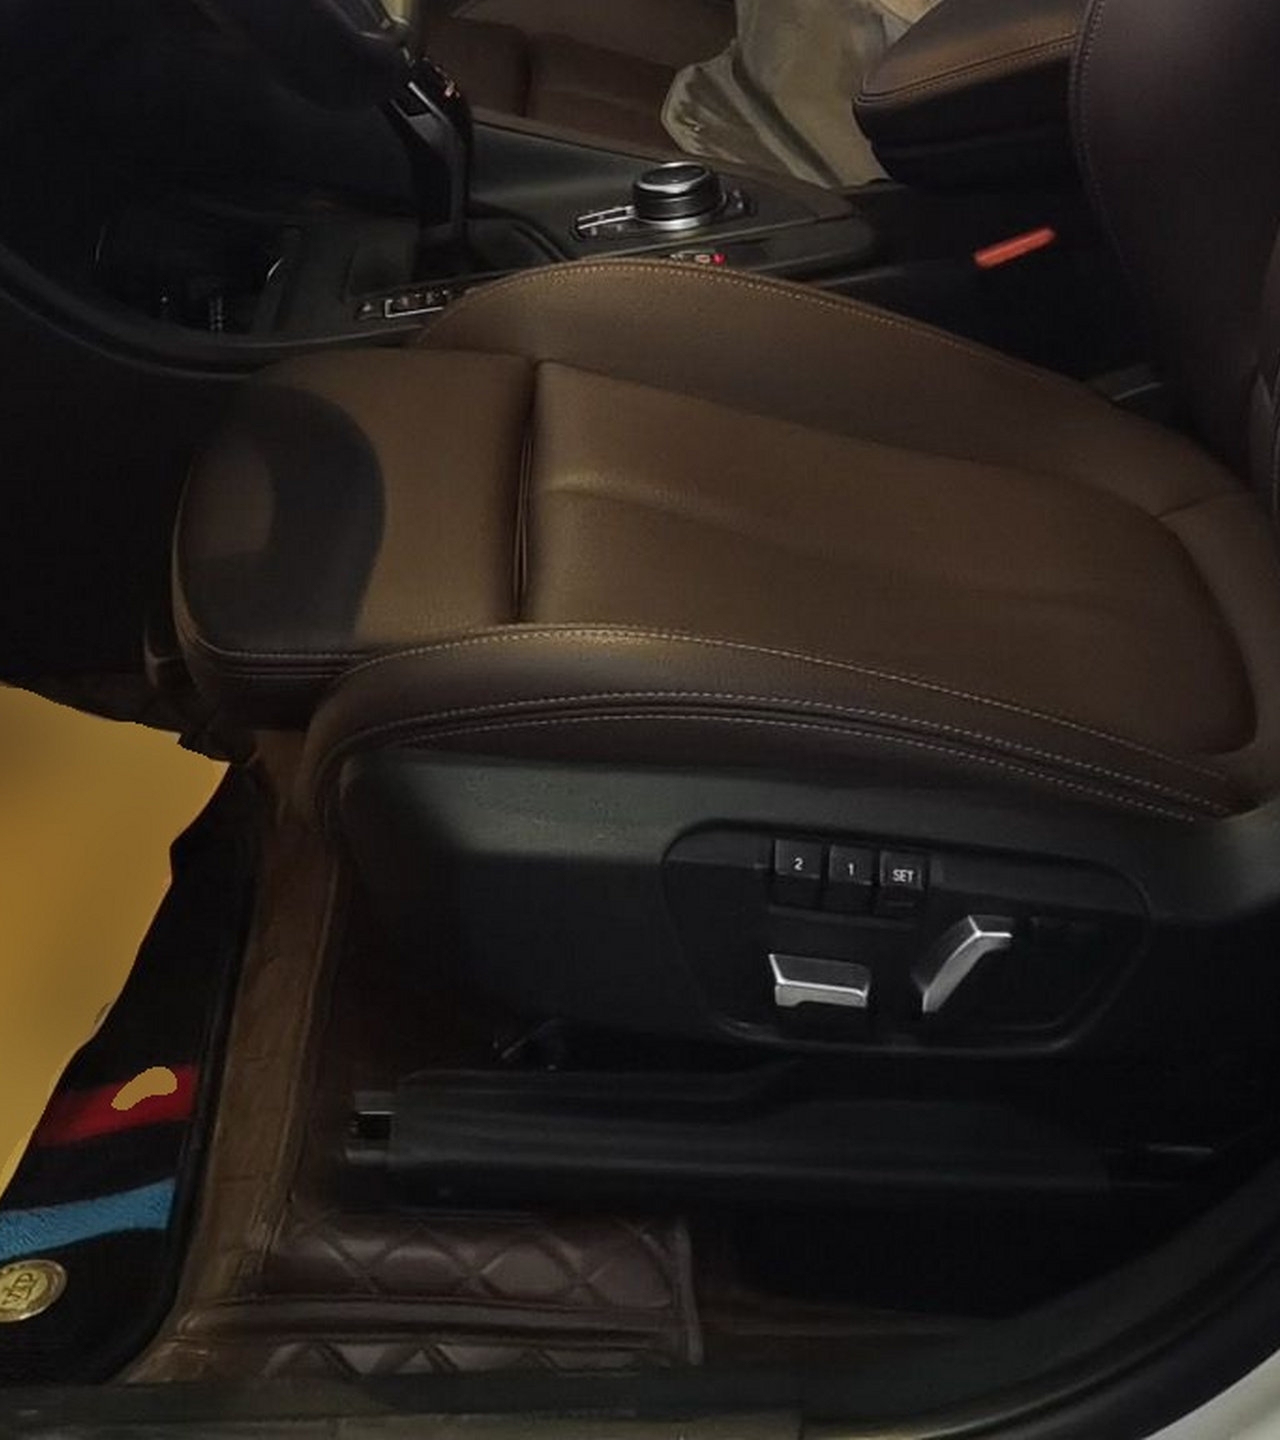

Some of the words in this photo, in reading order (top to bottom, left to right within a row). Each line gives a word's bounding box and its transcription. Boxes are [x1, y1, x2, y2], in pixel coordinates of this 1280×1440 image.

[793, 857, 804, 871] 2
[847, 862, 855, 876] 1
[892, 868, 915, 883] SET
